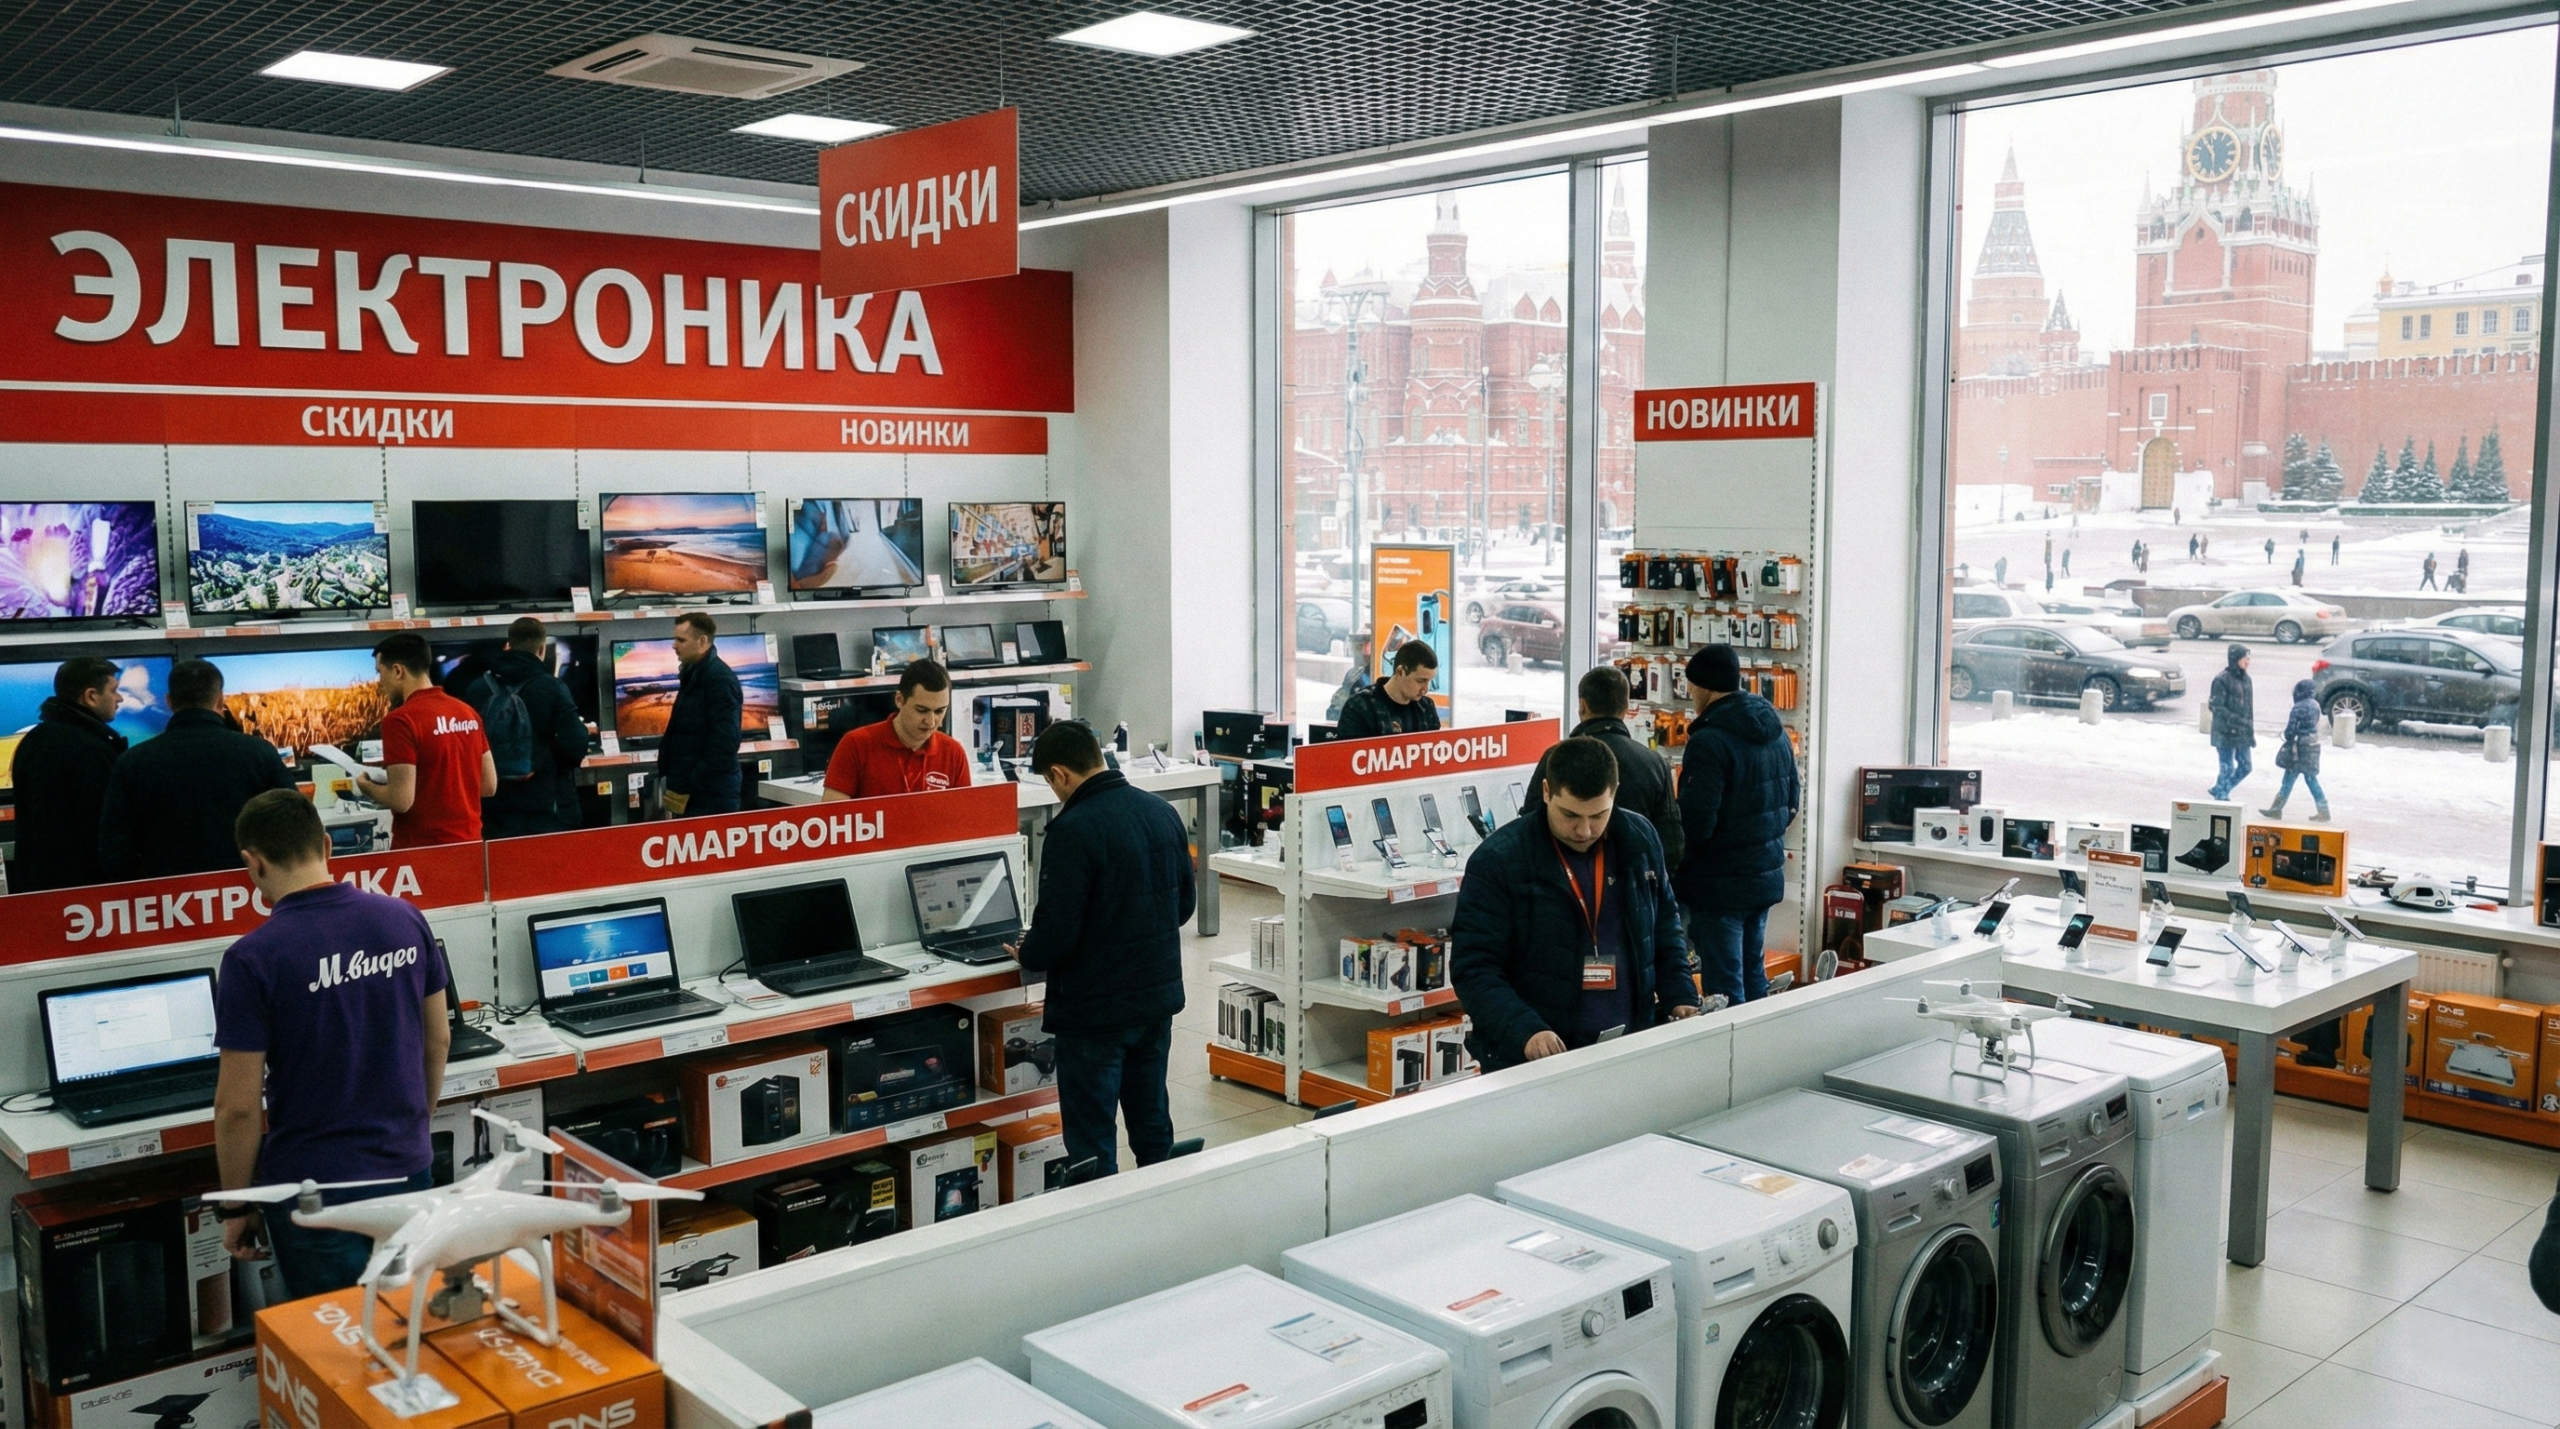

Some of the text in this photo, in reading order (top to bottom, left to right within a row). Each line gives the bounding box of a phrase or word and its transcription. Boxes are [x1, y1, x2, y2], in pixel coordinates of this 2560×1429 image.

[835, 165, 998, 248] СКИДКИ
[50, 229, 943, 375] ЭЛЕКТРОНИКА
[301, 404, 454, 443] СКИДКИ
[840, 416, 970, 447] НОВИНКИ
[1647, 395, 1800, 430] НОВИНКИ
[1353, 733, 1508, 776] СМАРТФОНЫ
[641, 810, 885, 868] СМАРТФОНЫ
[64, 865, 423, 942] ЭЛЕКТРКА
[262, 1343, 320, 1429] DNS
